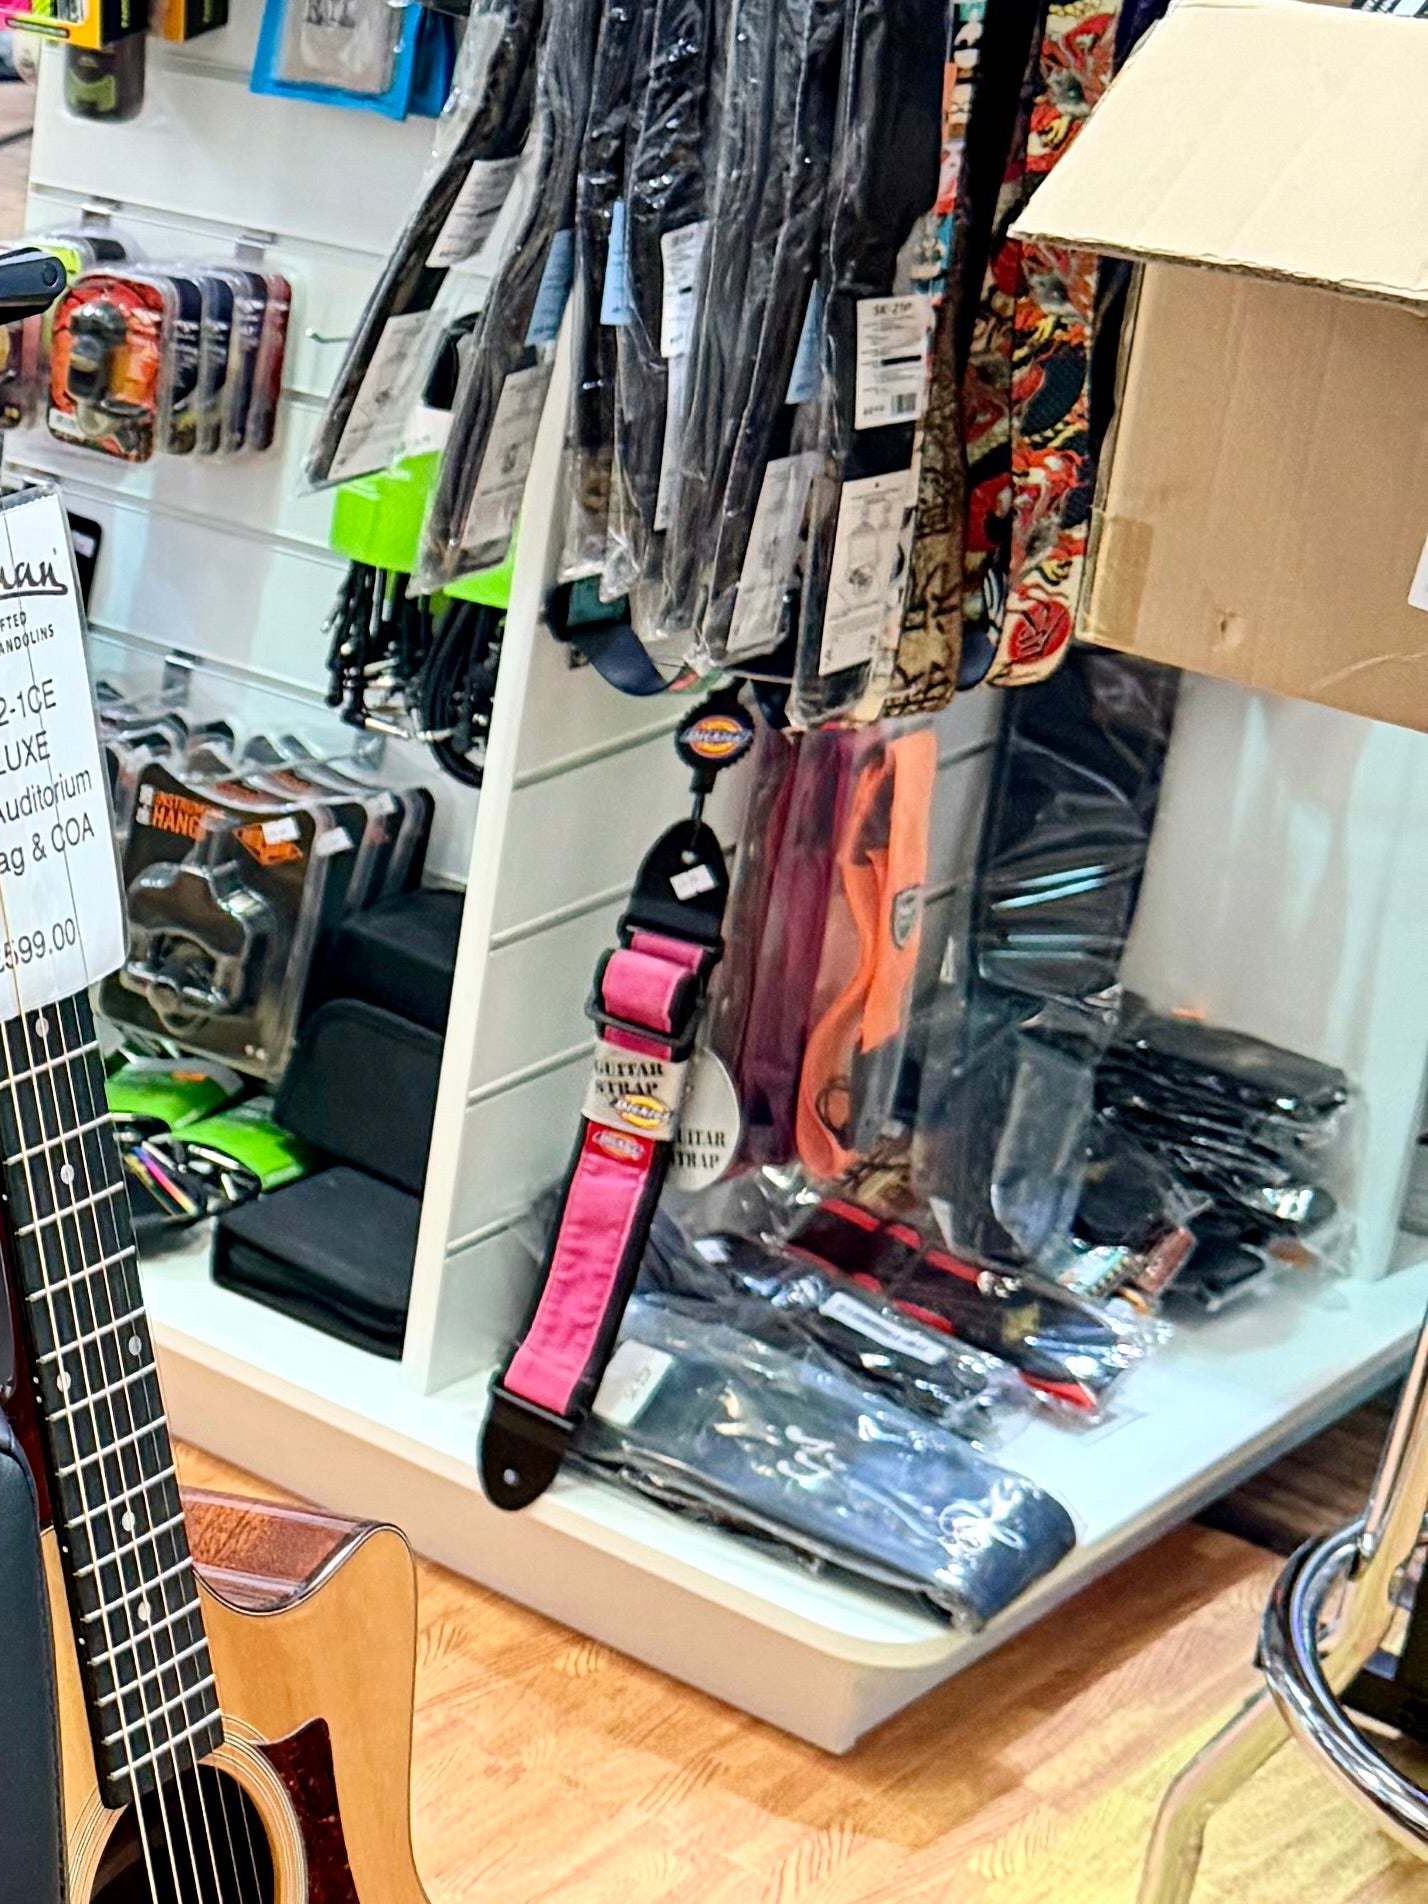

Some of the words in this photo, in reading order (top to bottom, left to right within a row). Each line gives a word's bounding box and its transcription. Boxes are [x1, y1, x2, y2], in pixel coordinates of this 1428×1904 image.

[31, 833, 50, 864] &
[49, 810, 97, 858] COA
[596, 1059, 664, 1077] GUITAR
[596, 1080, 659, 1097] STRAP
[676, 1127, 727, 1149] UITAR
